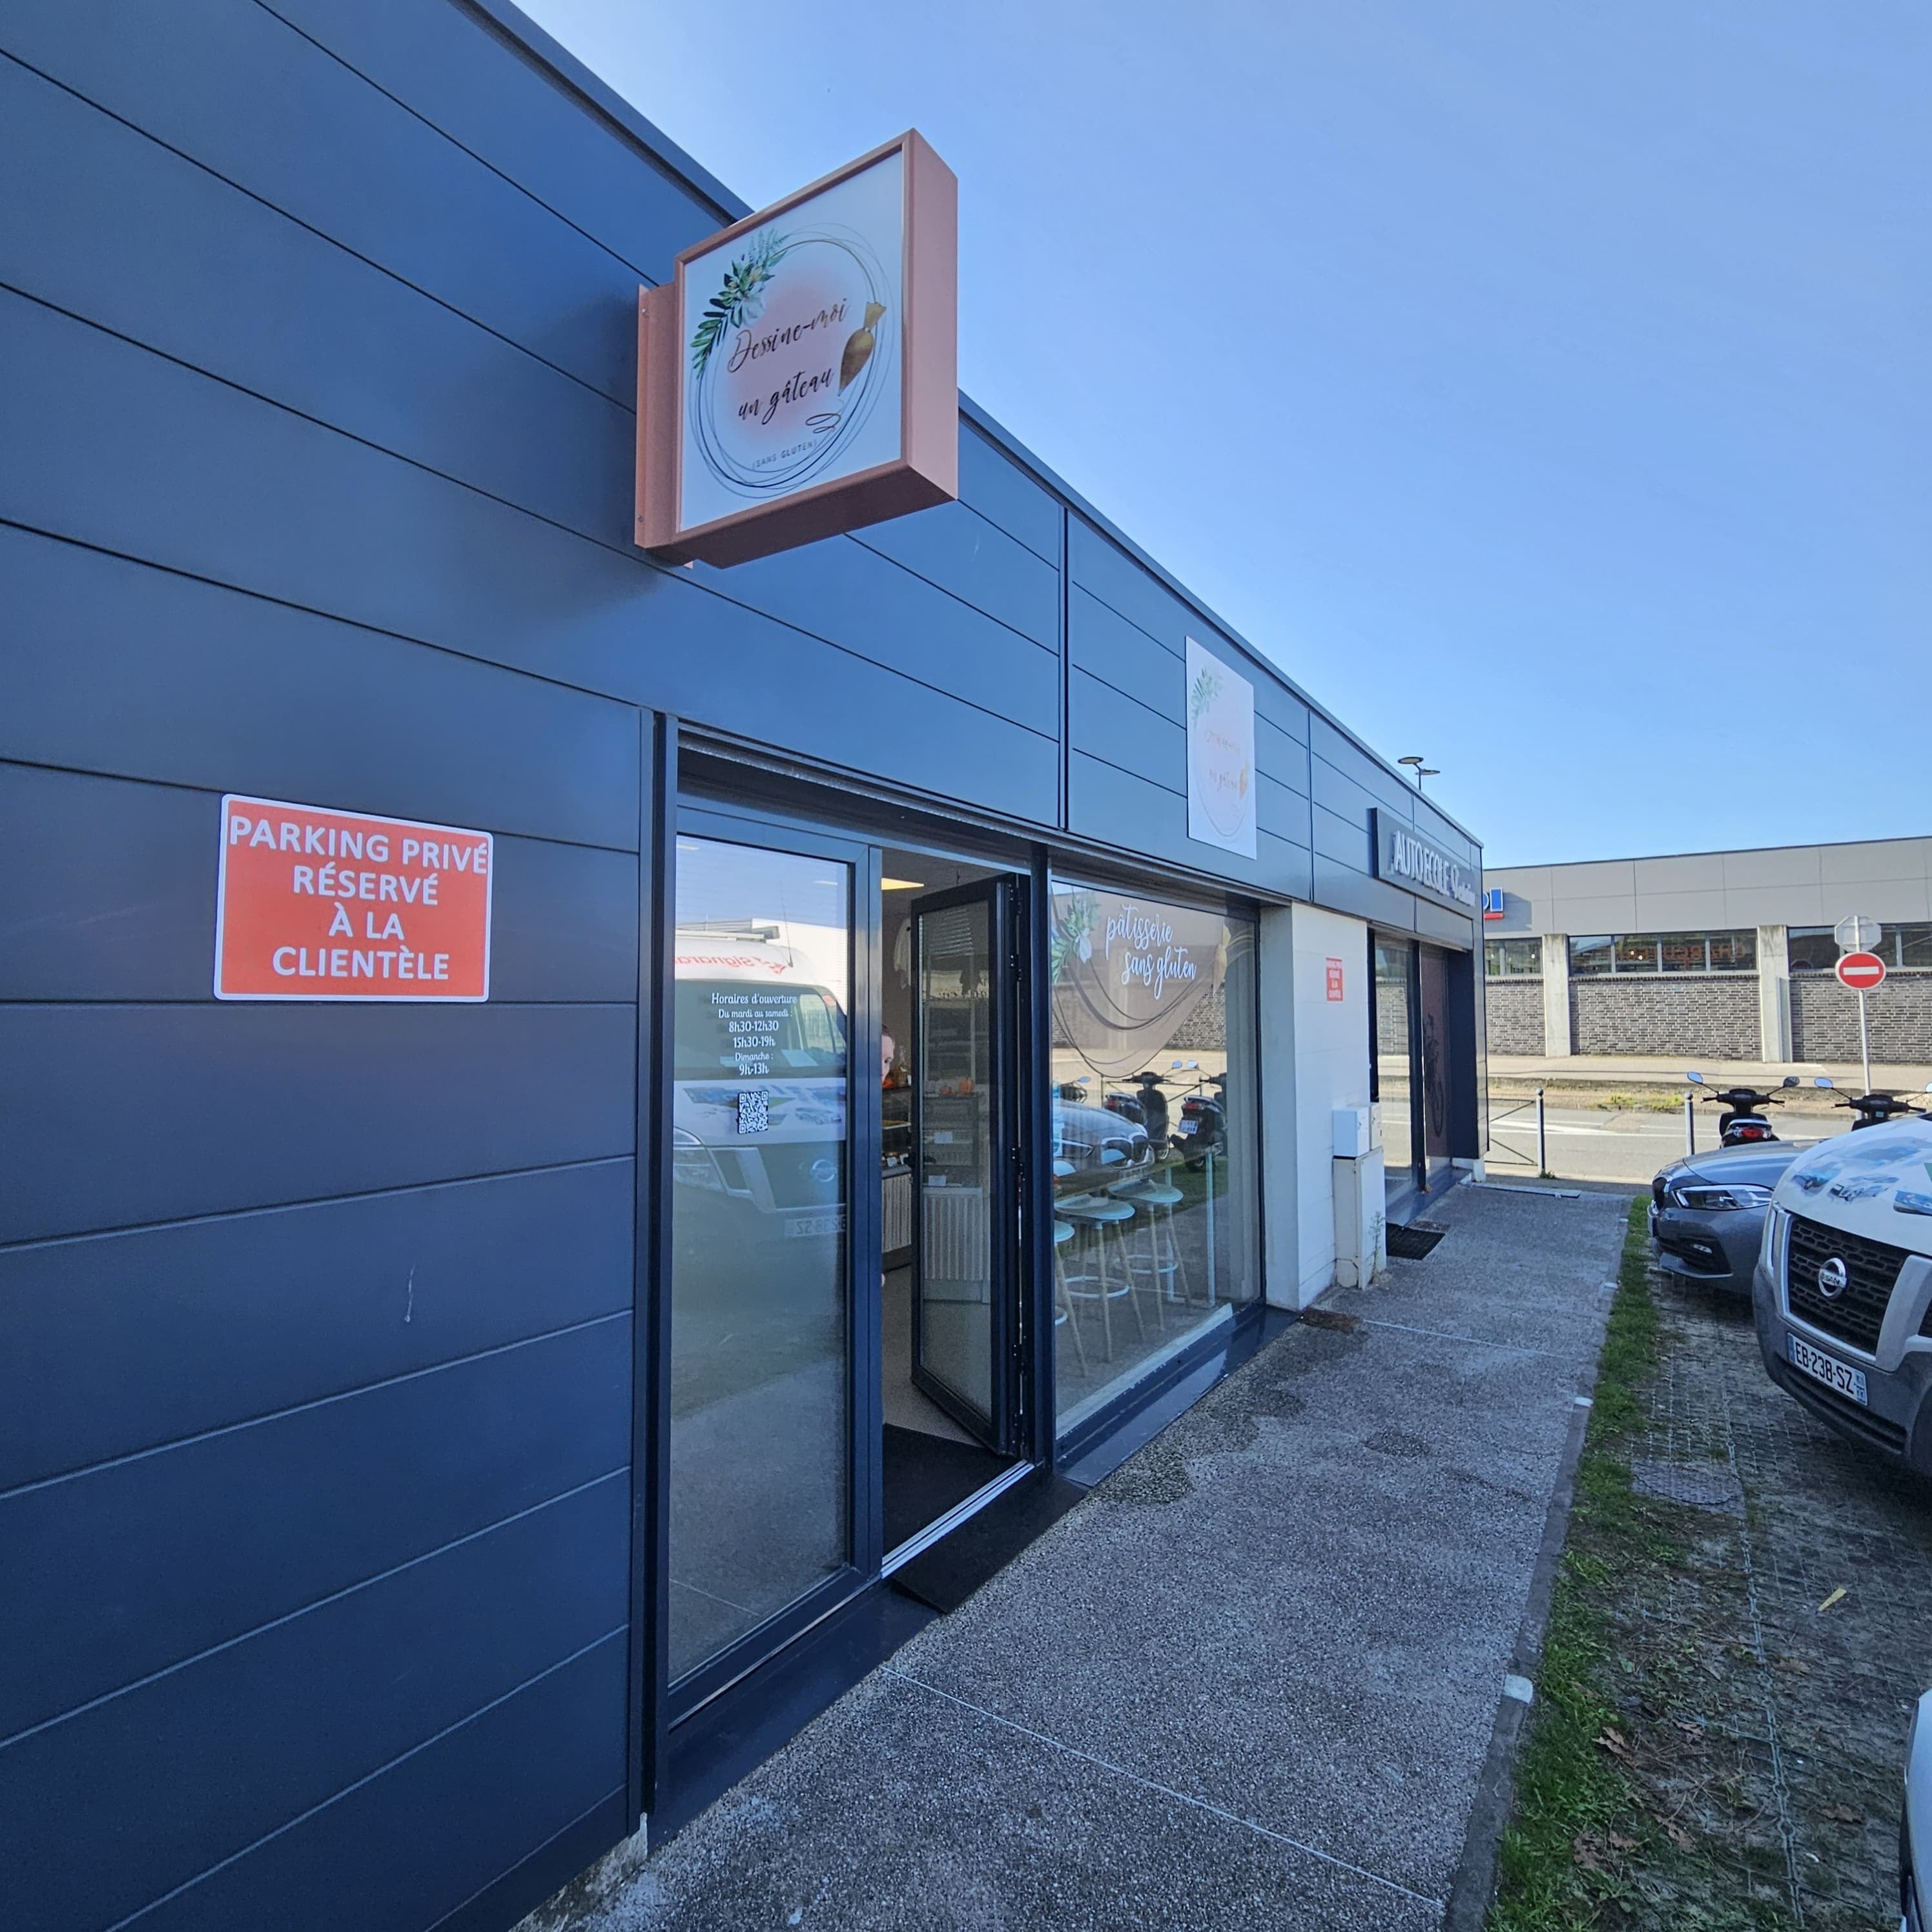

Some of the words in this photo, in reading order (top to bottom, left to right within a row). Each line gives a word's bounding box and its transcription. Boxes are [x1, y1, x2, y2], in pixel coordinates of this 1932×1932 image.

[727, 298, 847, 373] Dessine-moi
[738, 398, 761, 420] un
[761, 367, 834, 426] gâteau
[230, 816, 389, 863] PARKING
[402, 838, 488, 874] PRIVÉ
[293, 861, 438, 905] RÉSERVÉ
[329, 901, 353, 938] À
[366, 912, 404, 940] LA
[1105, 904, 1173, 960] pâtisserie
[272, 945, 449, 980] CLIENTÈLE
[1121, 951, 1155, 986] sans
[1154, 946, 1197, 1000] gluten
[711, 992, 749, 1005] Horaires
[751, 993, 797, 1005] d'ouverture
[718, 1009, 730, 1018] Du
[732, 1009, 753, 1018] mardi
[765, 1008, 788, 1018] samedi
[729, 1020, 779, 1033] 8h30-12h30
[733, 1036, 776, 1049] 15h30-19h
[735, 1052, 770, 1063] Dimanche
[739, 1063, 769, 1076] 9h-13h
